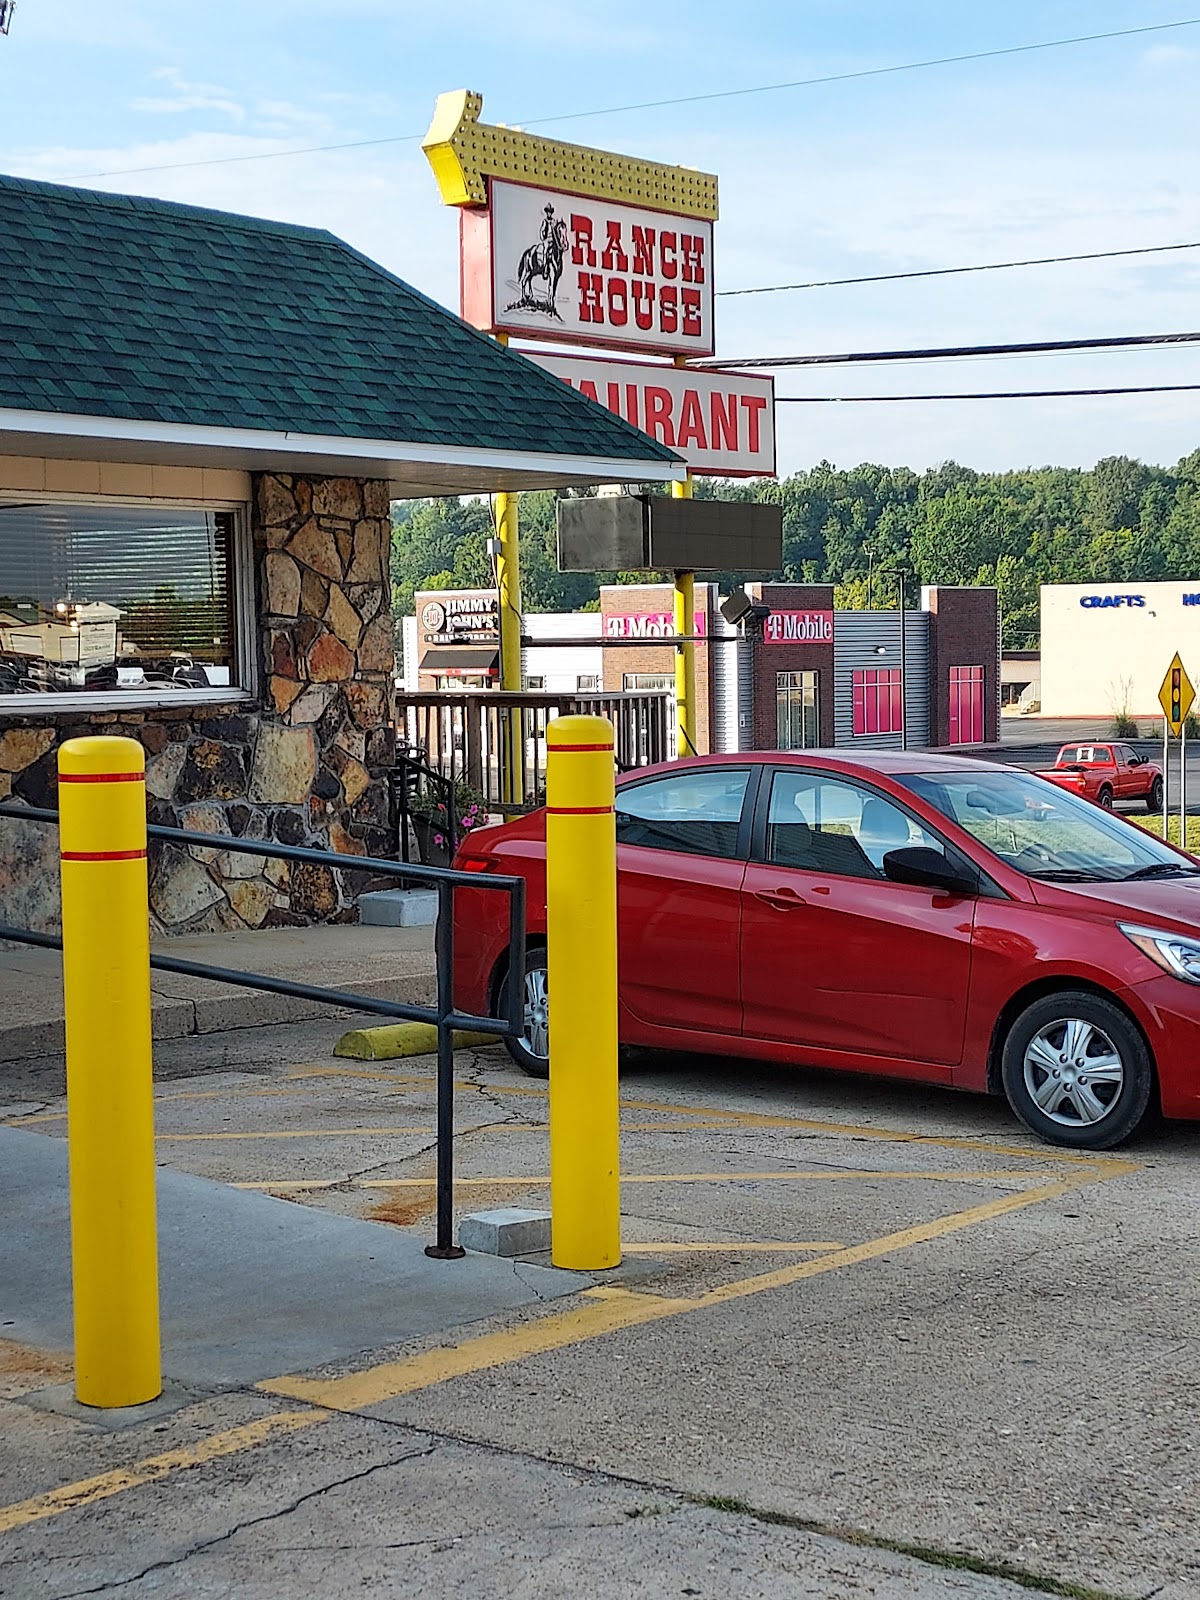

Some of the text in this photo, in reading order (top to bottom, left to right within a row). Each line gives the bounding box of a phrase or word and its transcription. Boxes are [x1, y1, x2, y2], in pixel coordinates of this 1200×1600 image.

[570, 213, 705, 284] RANCH
[577, 271, 702, 337] HOUSE
[444, 598, 494, 616] JIMMY
[1079, 594, 1147, 609] CRAFTS
